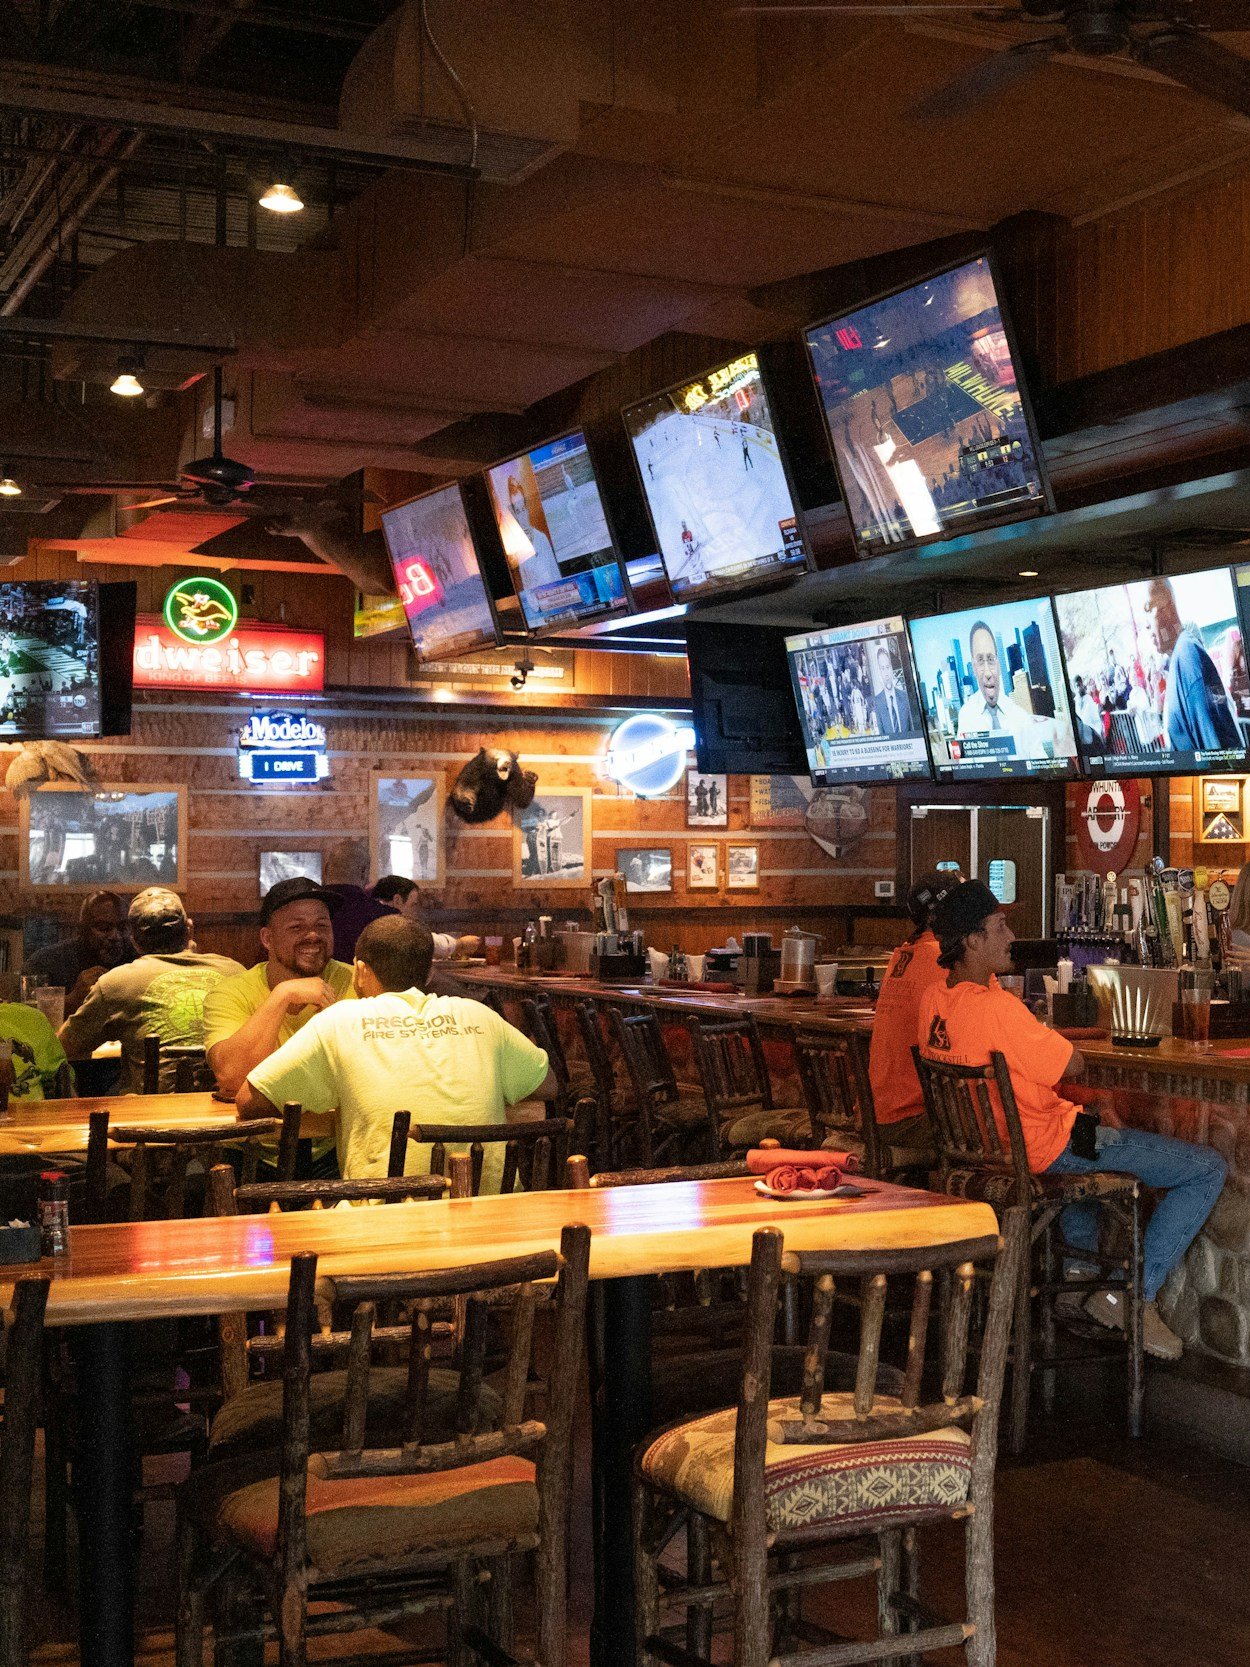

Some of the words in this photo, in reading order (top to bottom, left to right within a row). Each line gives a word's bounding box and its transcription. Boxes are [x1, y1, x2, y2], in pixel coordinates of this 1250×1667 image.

[943, 361, 1020, 421] MILWAUKE
[136, 634, 319, 676] dweiser
[150, 672, 182, 682] KING
[184, 673, 201, 682] OF
[205, 673, 249, 685] BEERS
[249, 716, 320, 742] Modelo
[273, 761, 304, 772] DRIVE
[363, 1029, 395, 1041] FIRE
[464, 1025, 485, 1035] INC.
